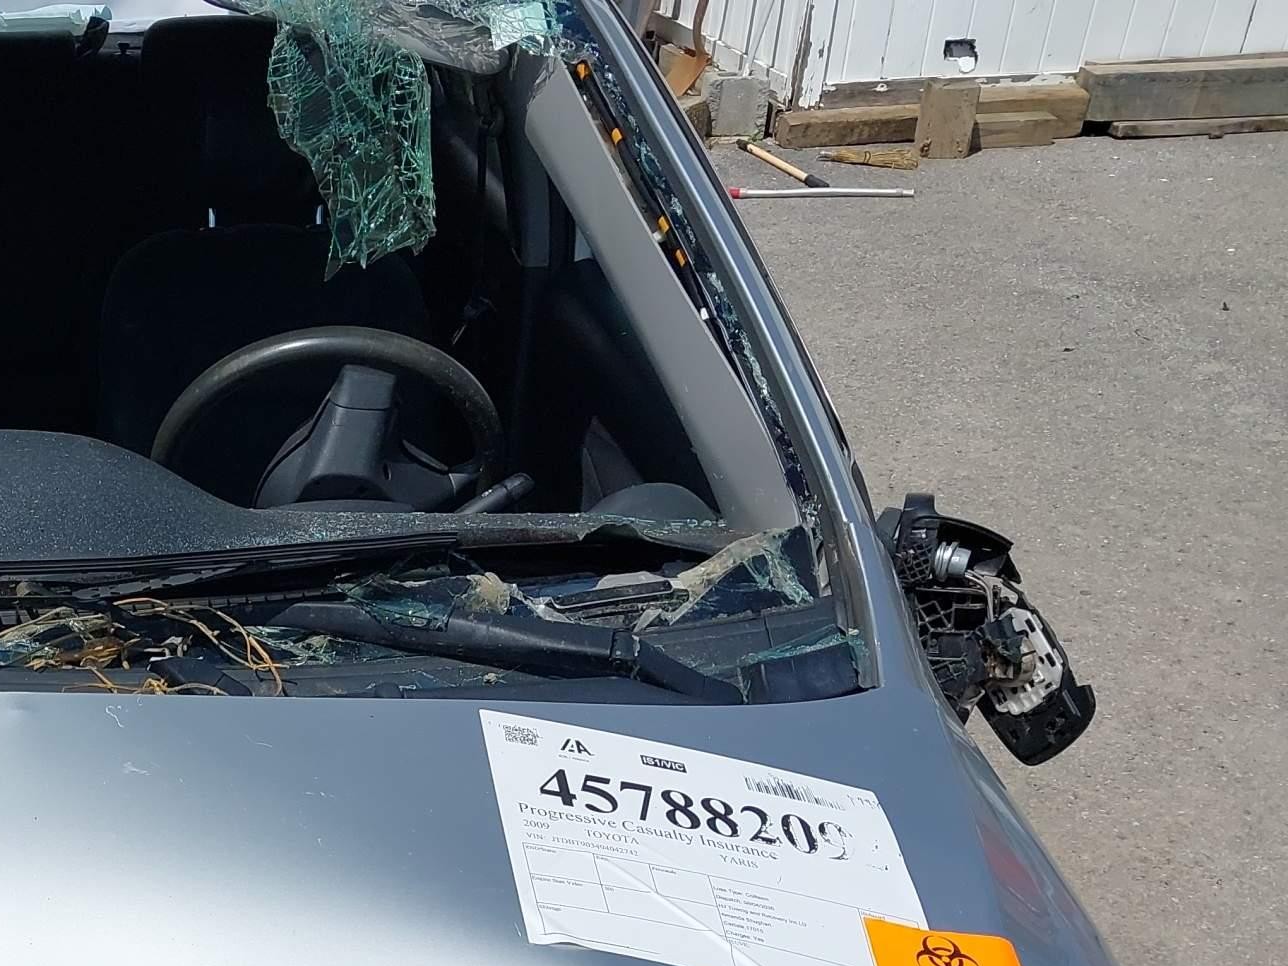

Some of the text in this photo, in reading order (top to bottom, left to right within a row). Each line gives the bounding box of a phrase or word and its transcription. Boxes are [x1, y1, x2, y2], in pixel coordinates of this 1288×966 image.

[518, 802, 779, 860] Progressive Casualty Insurance
[540, 769, 851, 860] 45788209
[523, 819, 759, 869] 2009 TOYOTA YARIS
